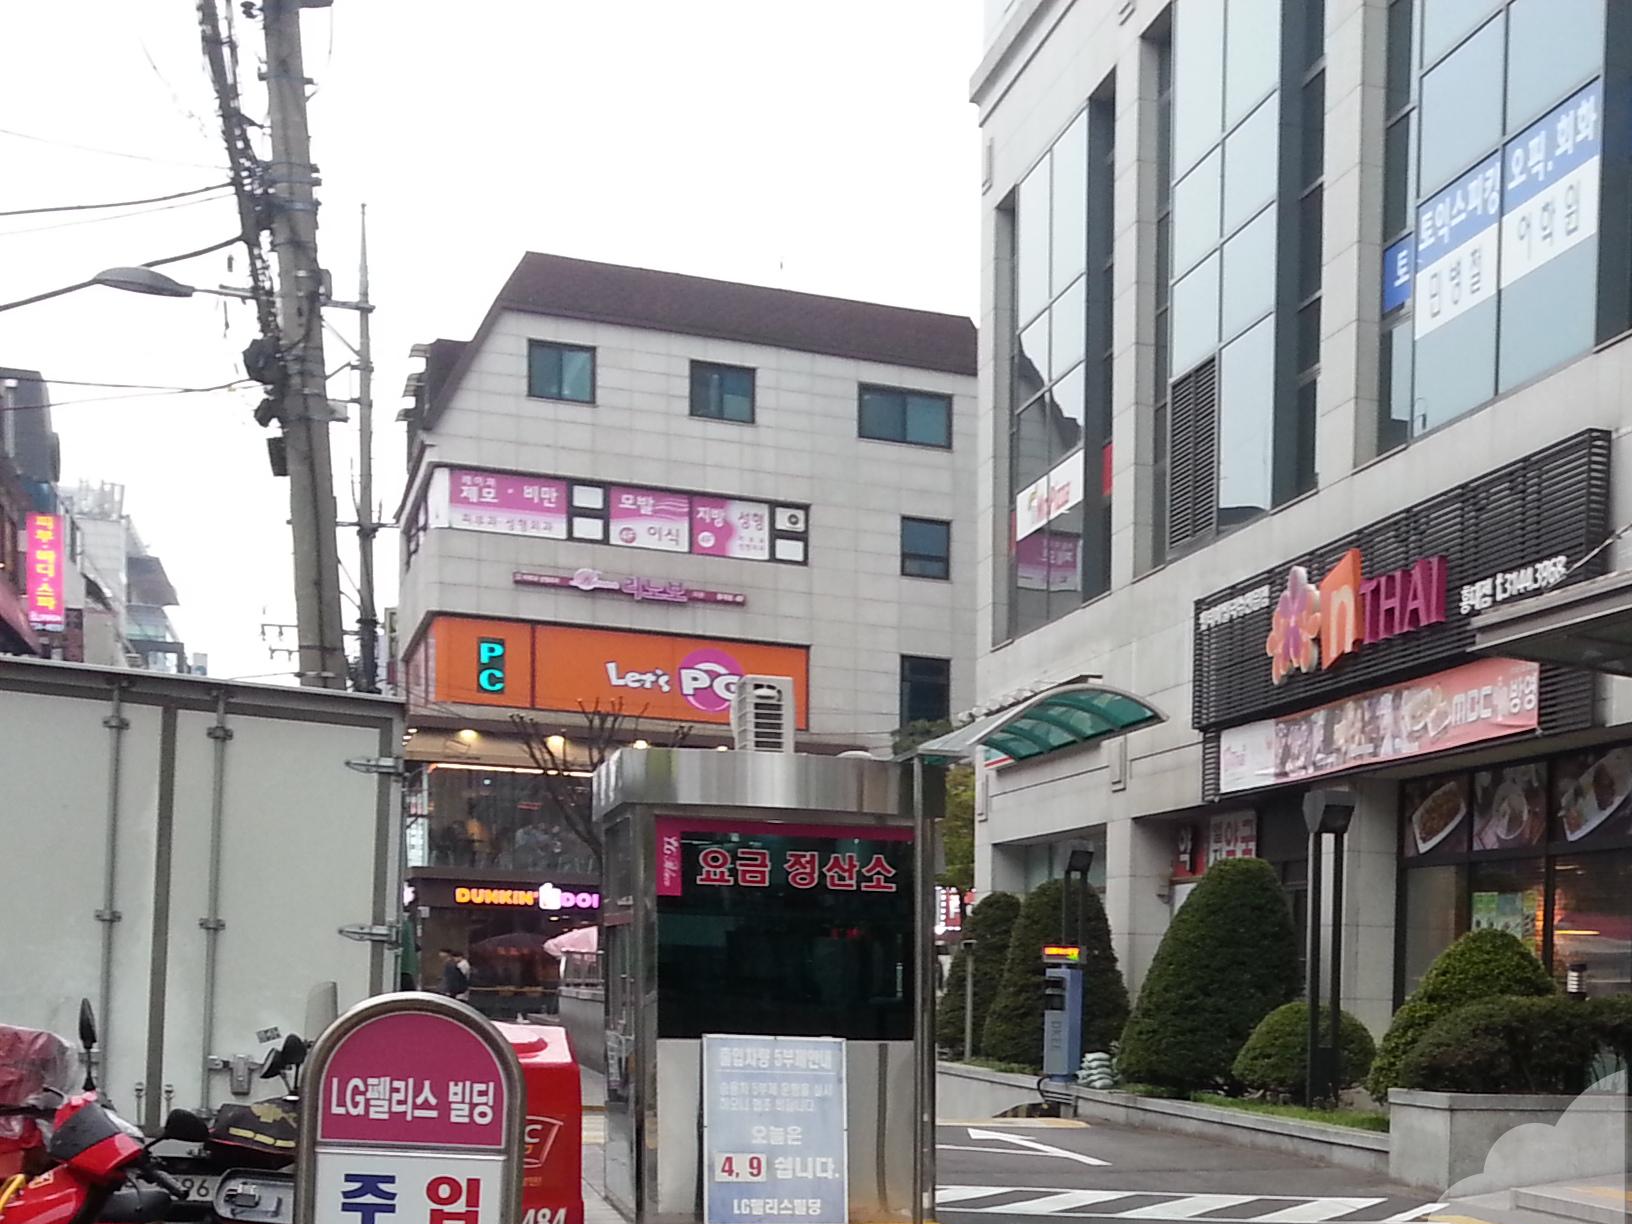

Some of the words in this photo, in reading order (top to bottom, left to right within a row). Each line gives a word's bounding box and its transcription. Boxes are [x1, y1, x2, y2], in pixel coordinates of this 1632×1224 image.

[1419, 161, 1501, 251] 토익스피킹
[1555, 95, 1597, 156] 회화
[1518, 181, 1580, 262] 어학원
[460, 485, 499, 503] 제모
[523, 485, 560, 508] 비만
[619, 494, 656, 516] 모발
[696, 507, 726, 528] 지방
[648, 526, 681, 547] 이식
[1359, 555, 1447, 645] THAI
[478, 641, 505, 693] PC
[605, 661, 672, 693] Let's
[1452, 685, 1493, 726] MBC
[696, 847, 771, 888] 요금
[784, 851, 897, 893] 정산소
[455, 887, 539, 905] DUNKIN'
[448, 1080, 495, 1126] 빌딩
[751, 1125, 803, 1145] 오늘은
